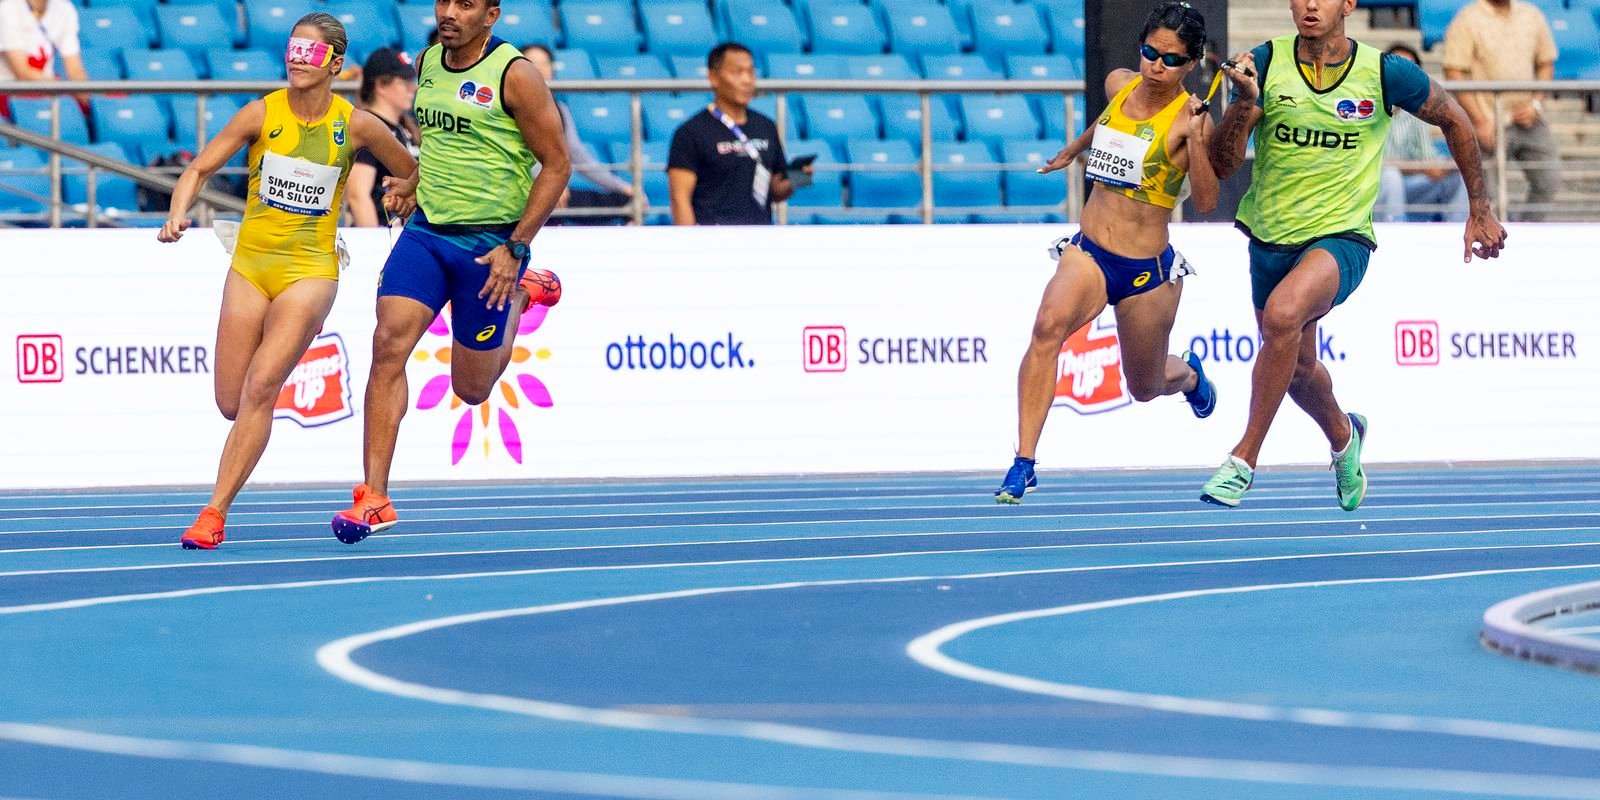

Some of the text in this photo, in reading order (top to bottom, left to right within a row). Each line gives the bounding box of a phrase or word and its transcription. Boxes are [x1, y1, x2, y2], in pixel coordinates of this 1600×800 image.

[416, 106, 472, 134] GUIDE
[1274, 122, 1360, 150] GUIDE
[1087, 157, 1126, 177] SANTOS
[1112, 155, 1135, 170] DOS
[268, 175, 326, 195] SIMPLICIO
[268, 186, 320, 205] DA SILVA
[273, 202, 284, 210] NEW
[284, 205, 300, 213] DELHI
[606, 331, 755, 370] ottobock.
[809, 334, 988, 364] DB SCHENKER
[1190, 326, 1346, 362] ottok.
[1401, 329, 1577, 359] DB SCHENKER
[23, 343, 209, 375] DB SCHENKER
